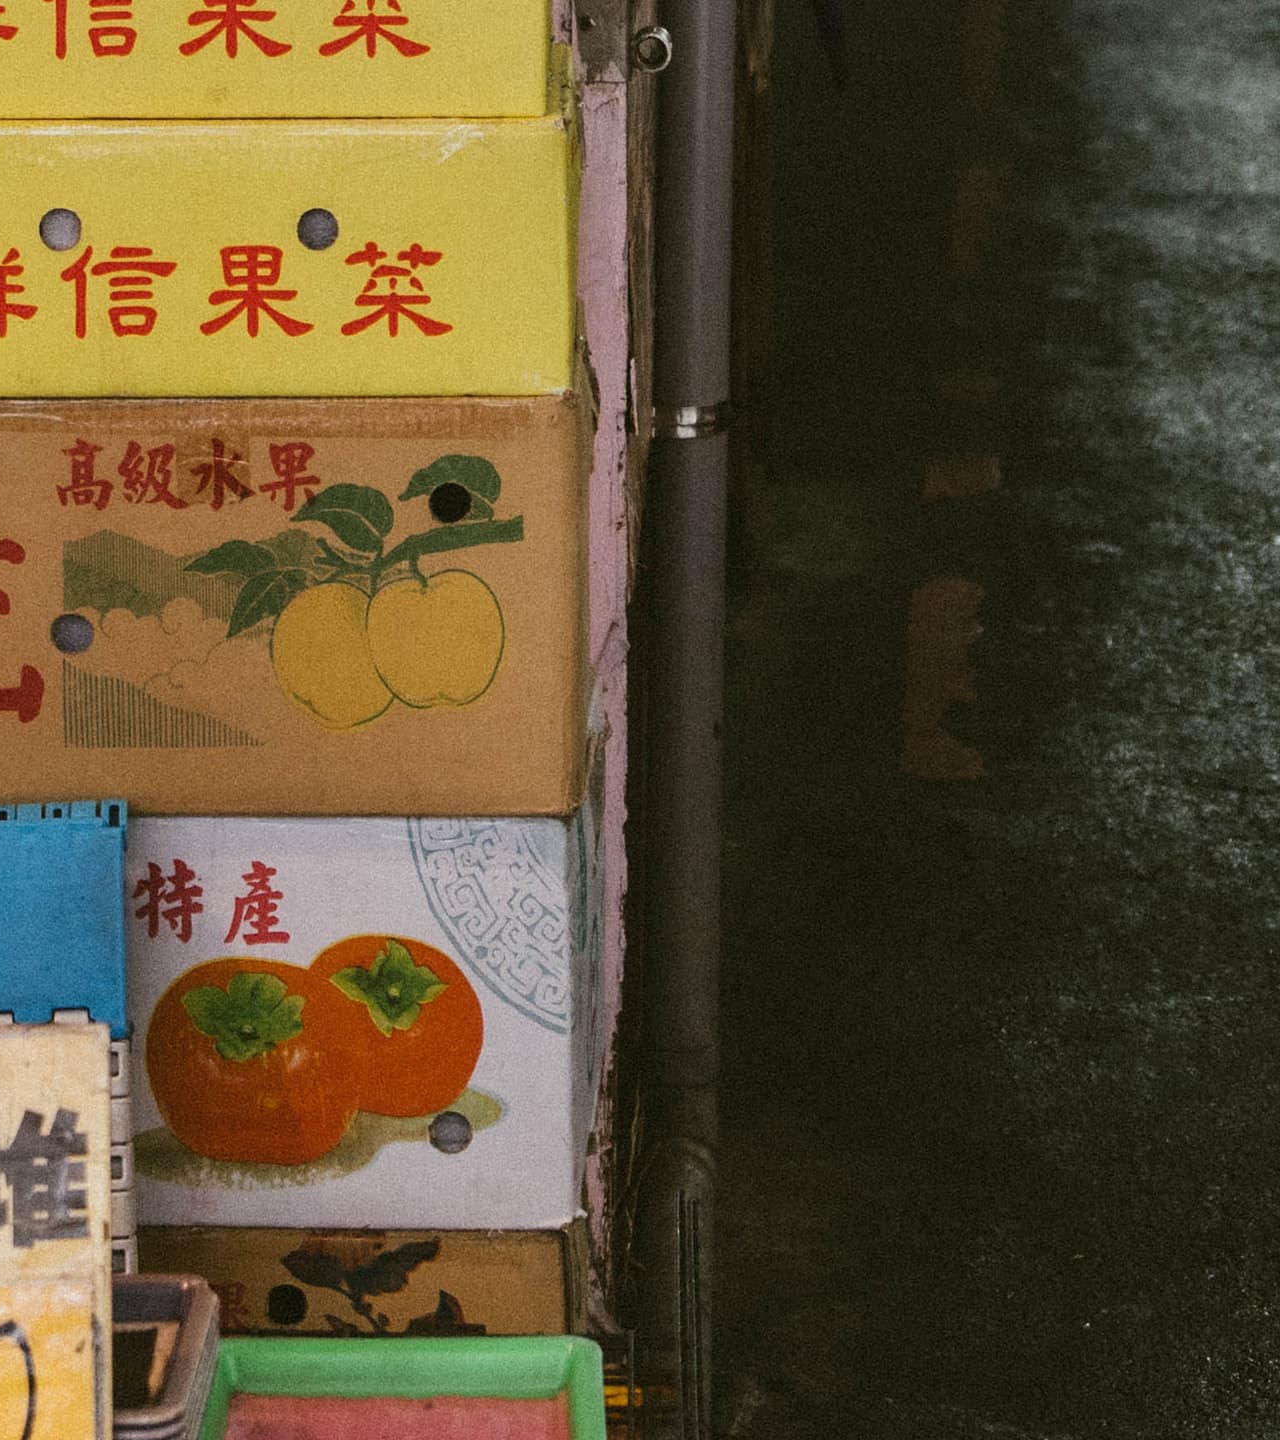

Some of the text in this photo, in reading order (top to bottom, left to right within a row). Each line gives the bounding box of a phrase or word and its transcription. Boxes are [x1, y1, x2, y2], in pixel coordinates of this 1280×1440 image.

[55, 437, 323, 511] 高級水果
[132, 859, 293, 949] 特產
